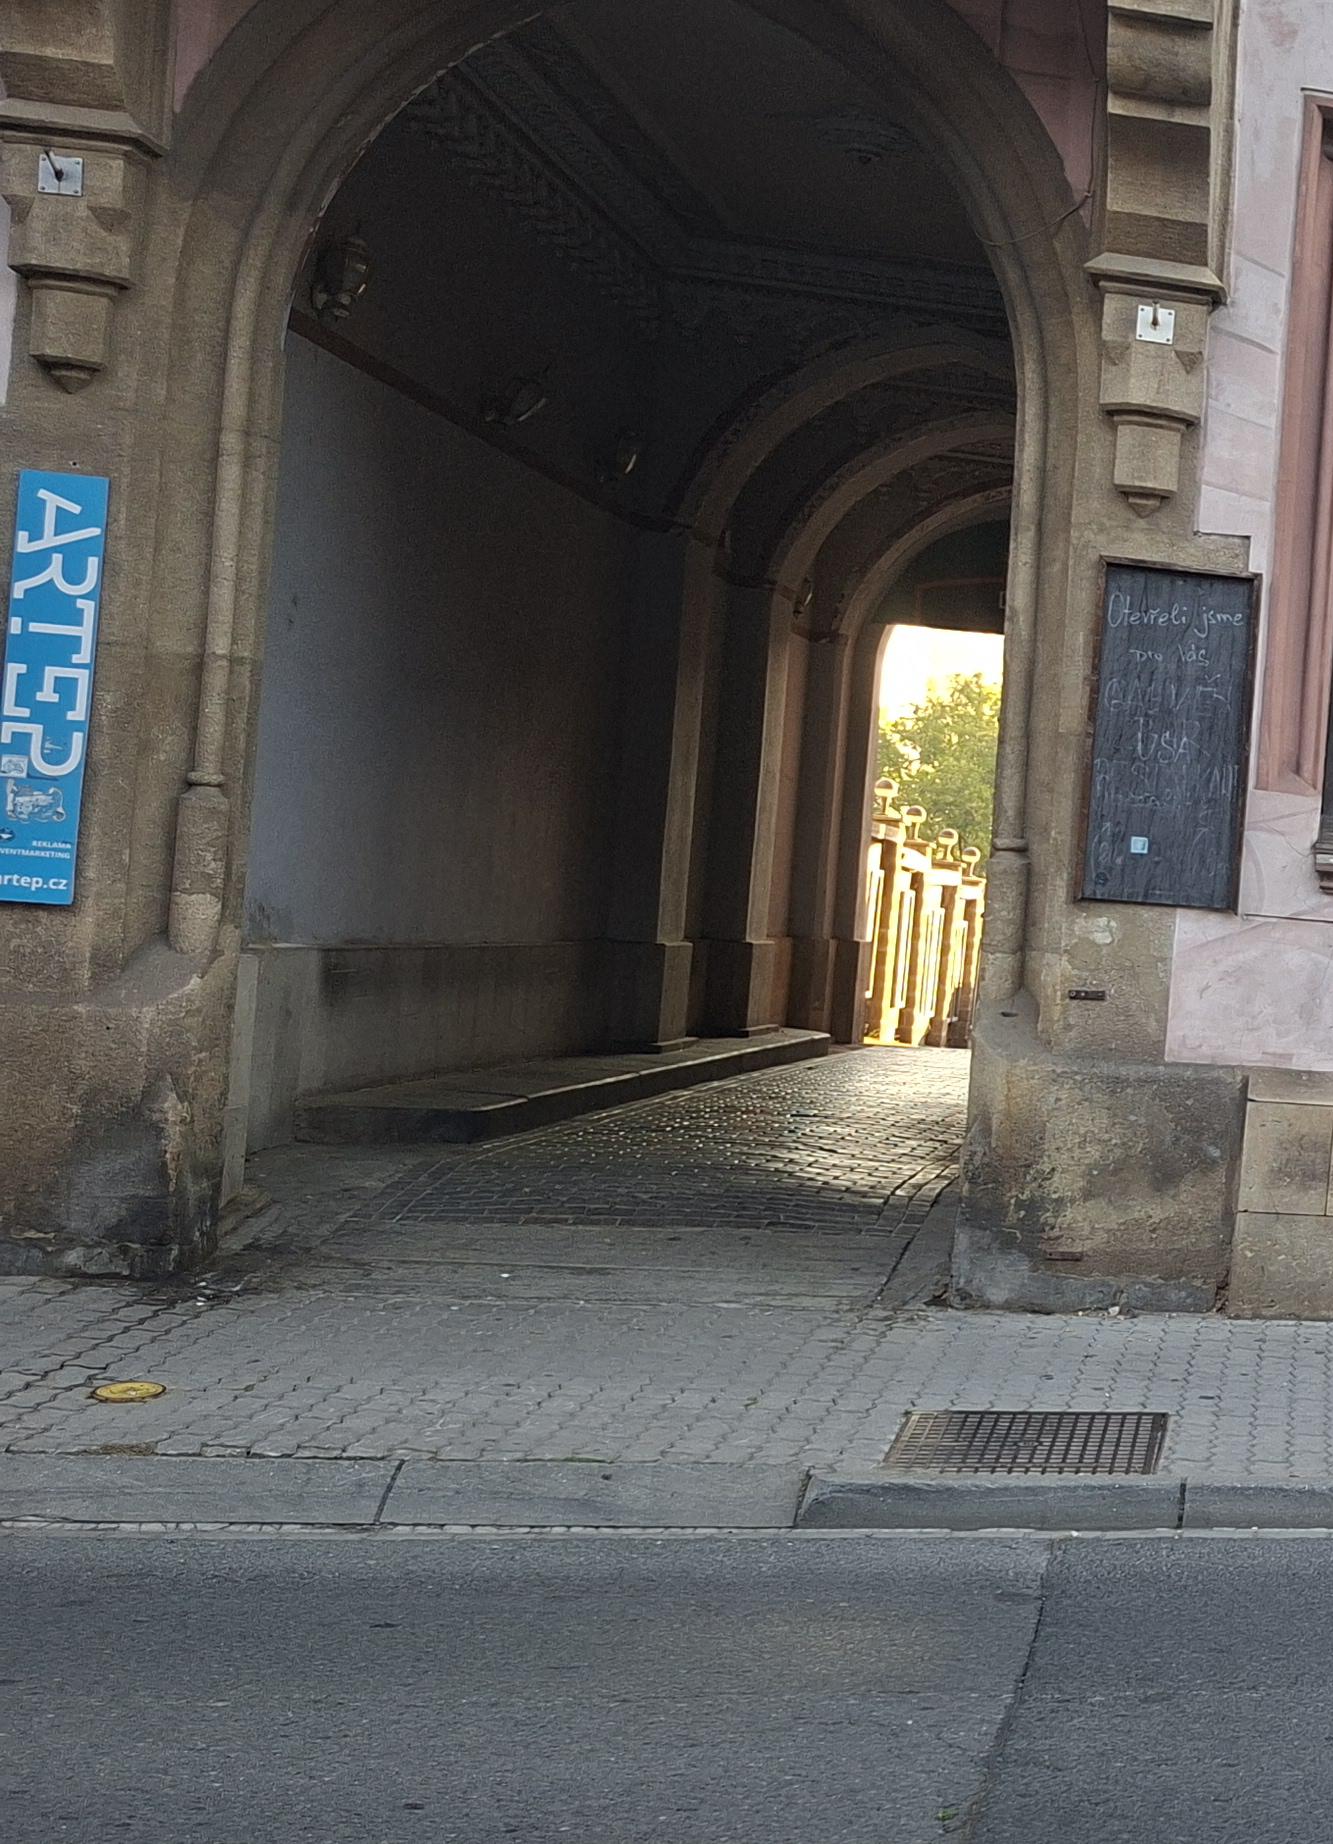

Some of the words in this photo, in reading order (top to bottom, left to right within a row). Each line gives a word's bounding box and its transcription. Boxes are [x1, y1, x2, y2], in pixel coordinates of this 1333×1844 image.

[1108, 592, 1187, 628] Otevřeli
[1194, 606, 1244, 638] jsme
[0, 874, 68, 891] rtep.cz
